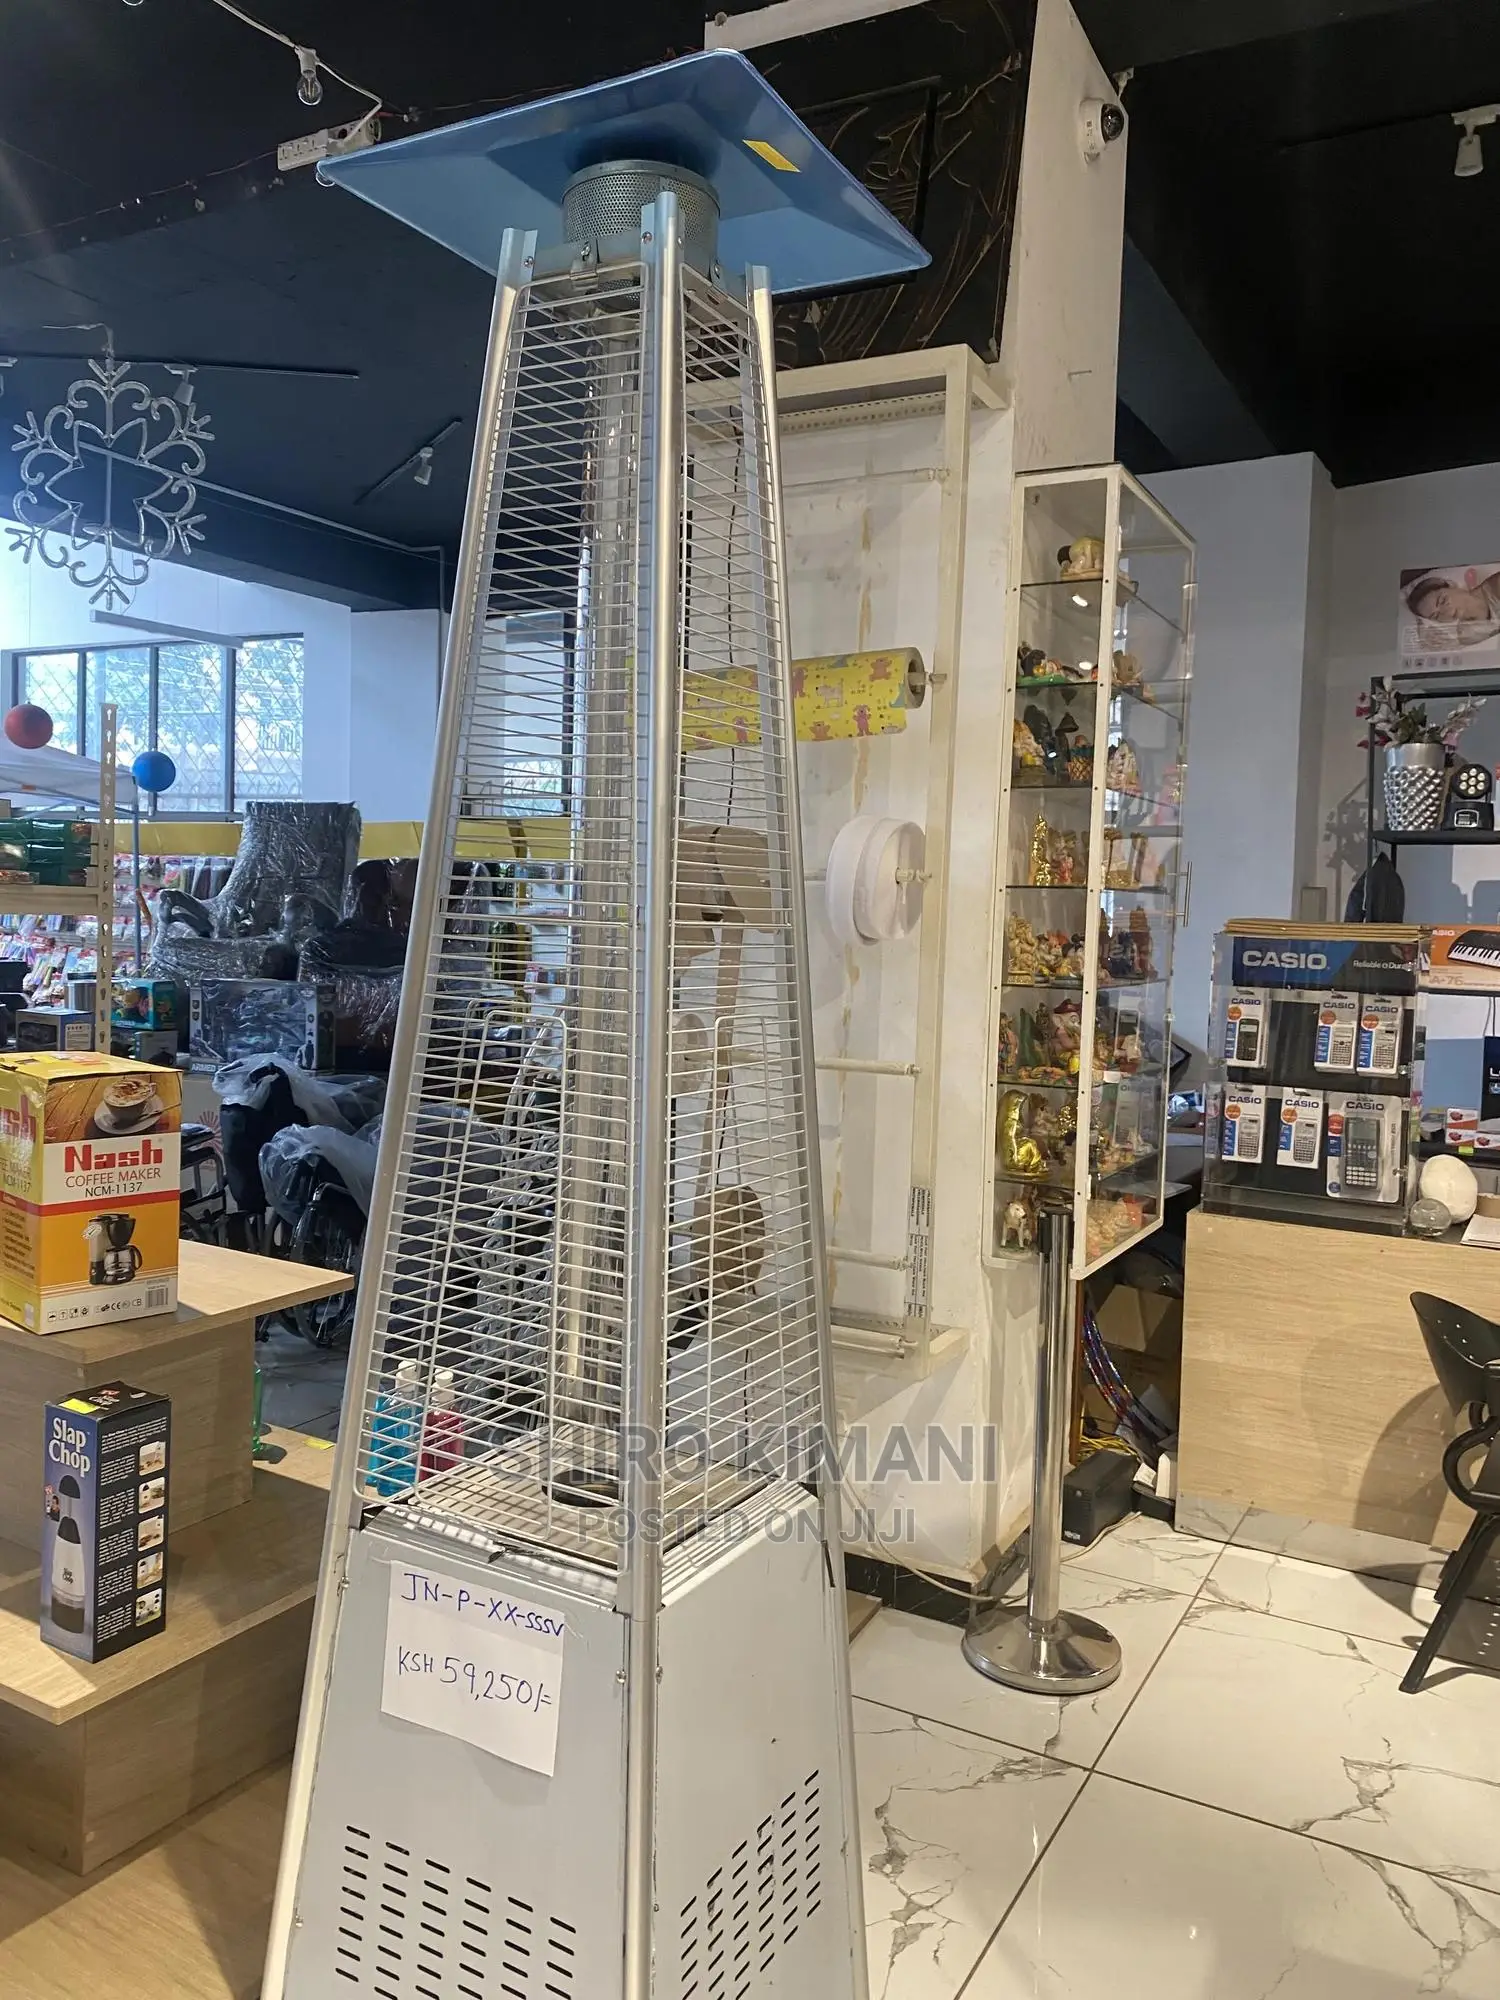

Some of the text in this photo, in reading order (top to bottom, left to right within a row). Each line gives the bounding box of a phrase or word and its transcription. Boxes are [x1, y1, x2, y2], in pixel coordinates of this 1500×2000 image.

[1432, 929, 1455, 937] ASIO
[1242, 950, 1328, 970] CASIO
[1353, 960, 1381, 968] Reliable
[1323, 1001, 1356, 1009] CASIO
[1365, 1005, 1399, 1014] CASIO
[1228, 1095, 1262, 1104] CASIO
[1285, 1099, 1319, 1109] CASIO
[1346, 1101, 1385, 1111] CASIO
[65, 1139, 163, 1173] Nash
[65, 1167, 161, 1188] COFFEE MAKER
[85, 1181, 143, 1198] NCM-1137
[53, 1417, 87, 1453] Slap
[48, 1439, 91, 1478] Chop
[398, 1645, 553, 1712] KSH 59,250/=
